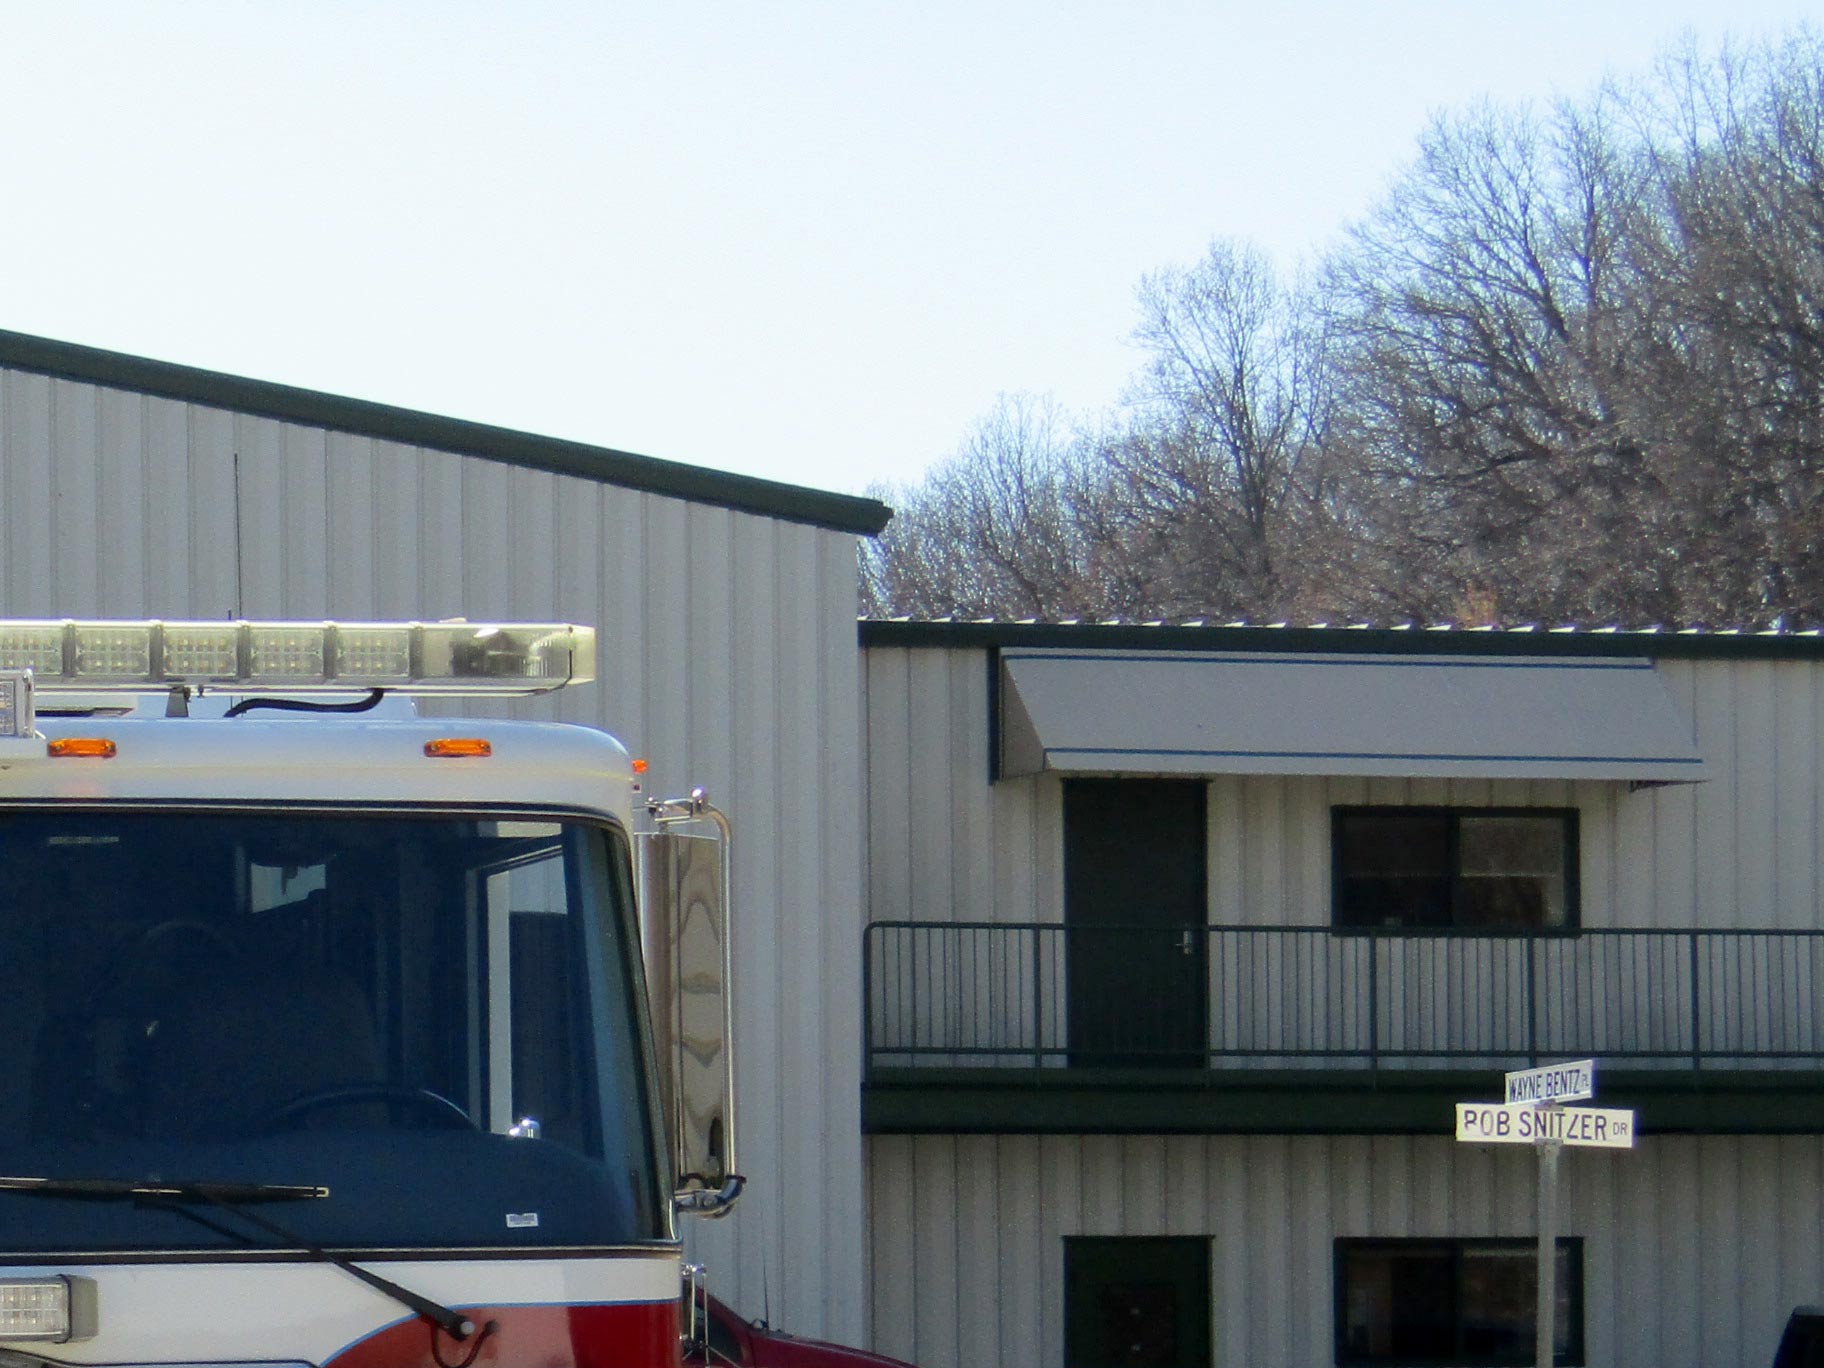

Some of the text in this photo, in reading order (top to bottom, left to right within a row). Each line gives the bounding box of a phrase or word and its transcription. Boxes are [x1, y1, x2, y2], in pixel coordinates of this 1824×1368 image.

[1508, 1074, 1542, 1102] WAYNE
[1546, 1069, 1580, 1097] BENTZ
[1518, 1111, 1607, 1140] SNITZER
[1613, 1121, 1628, 1135] DR
